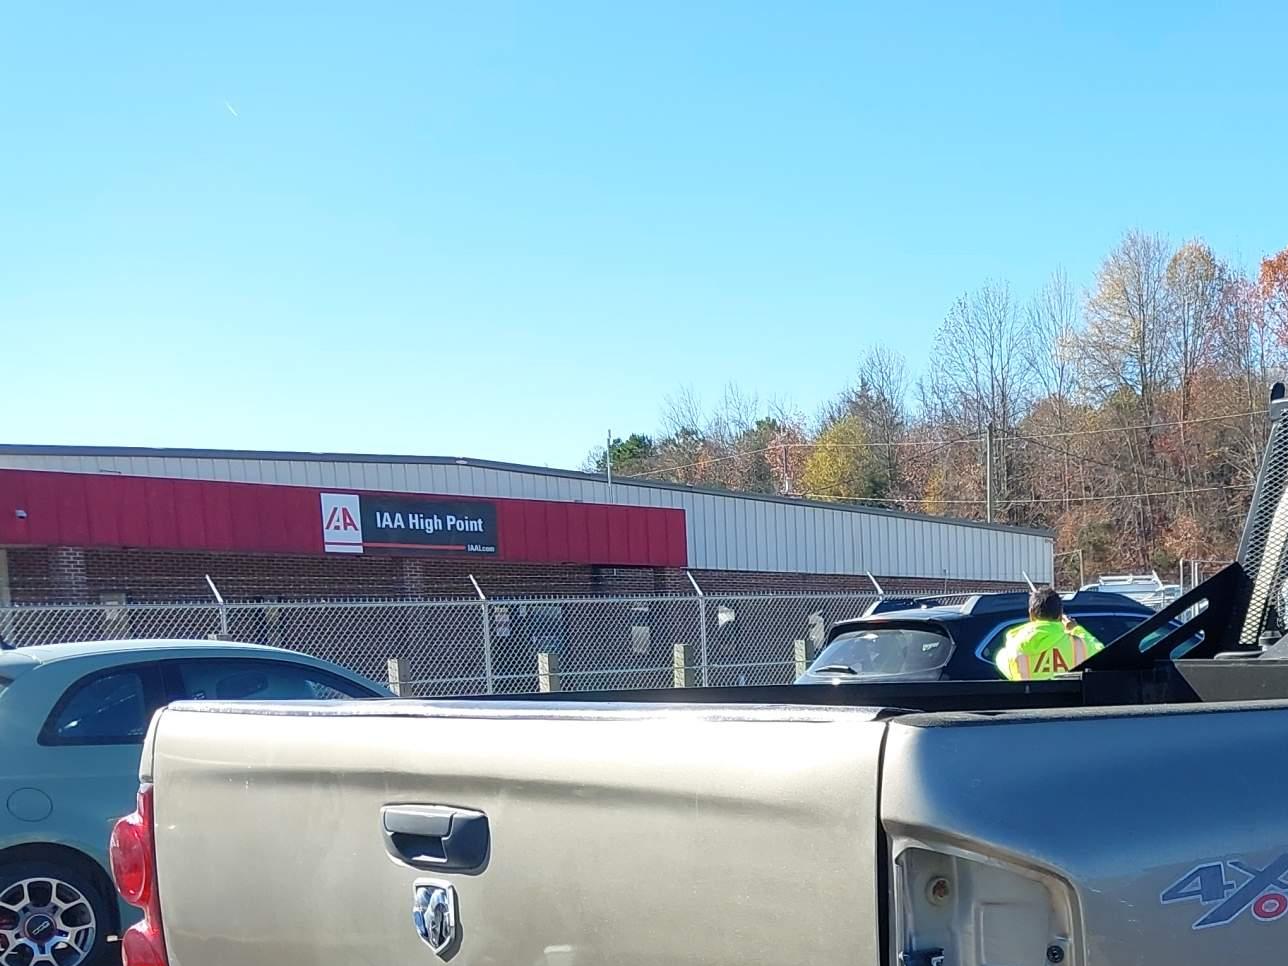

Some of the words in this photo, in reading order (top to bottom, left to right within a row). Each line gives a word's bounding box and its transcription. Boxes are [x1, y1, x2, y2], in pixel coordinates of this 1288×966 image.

[376, 511, 405, 530] IAA
[408, 513, 443, 534] High
[446, 516, 485, 532] Point
